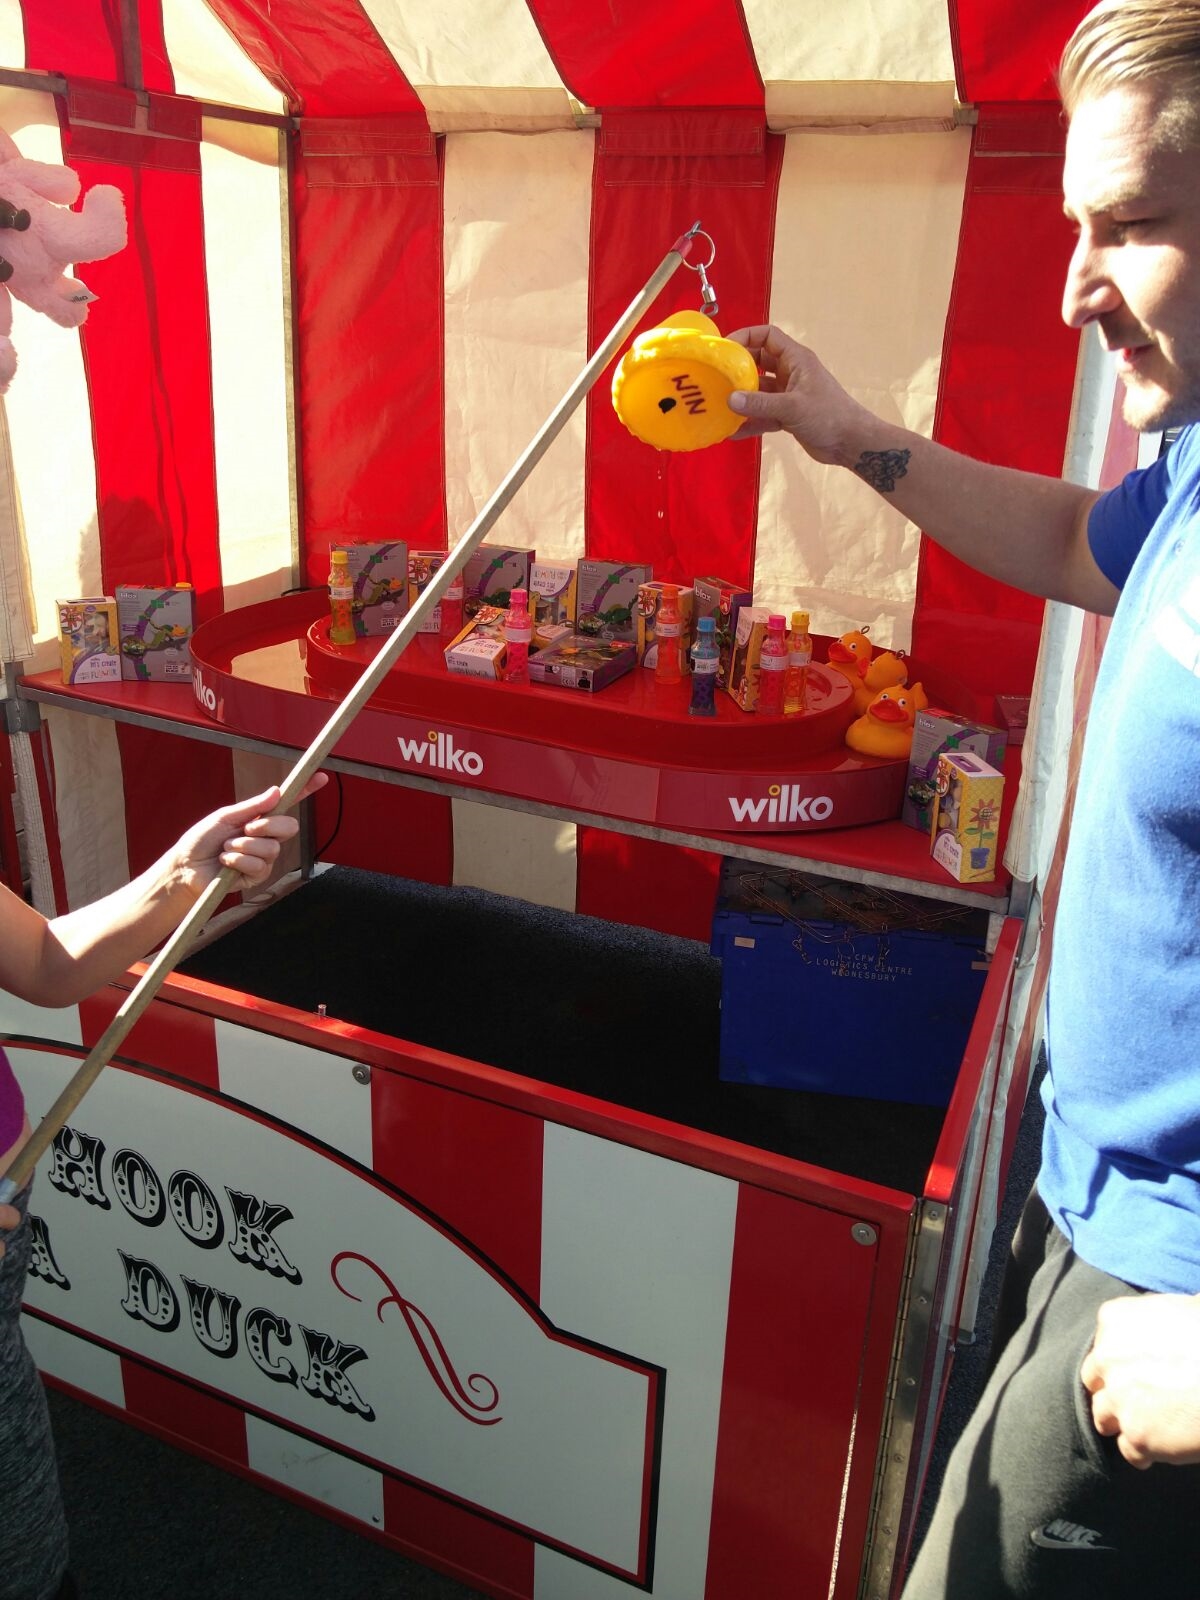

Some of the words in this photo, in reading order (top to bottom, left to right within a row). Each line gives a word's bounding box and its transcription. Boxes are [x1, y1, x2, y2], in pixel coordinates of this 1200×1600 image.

[671, 374, 707, 416] WIN
[695, 585, 712, 602] blox
[397, 730, 484, 776] wilko
[728, 784, 834, 823] wilko
[47, 1117, 303, 1286] HOOK
[116, 1247, 376, 1423] DUCK
[1043, 1518, 1103, 1544] NIKE
